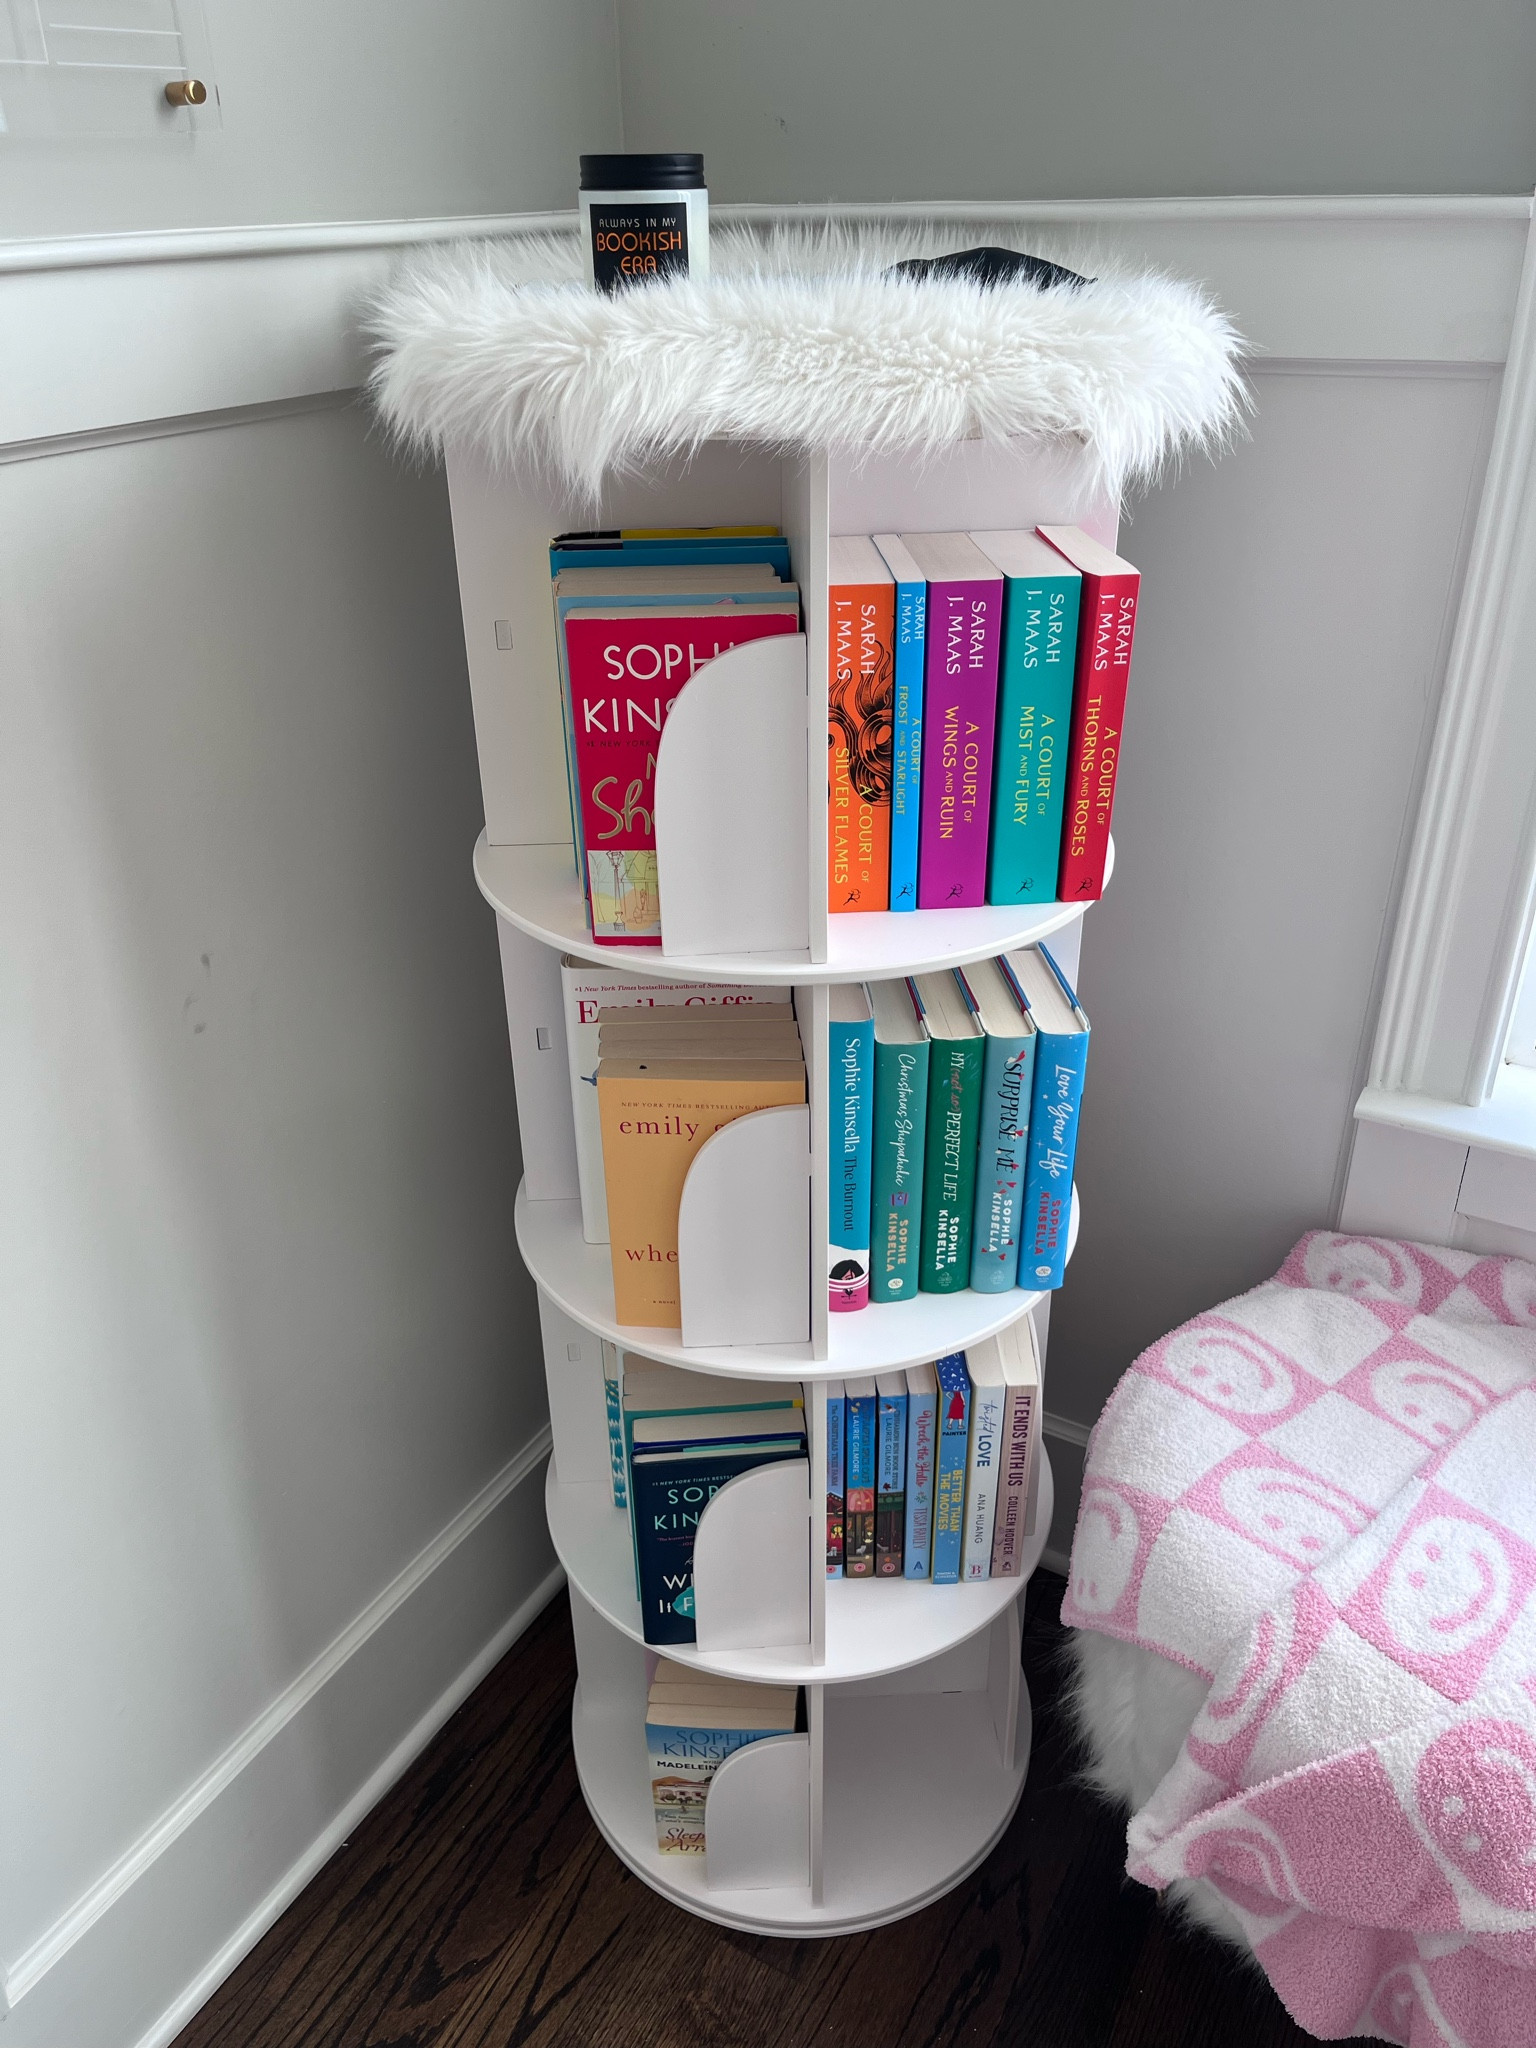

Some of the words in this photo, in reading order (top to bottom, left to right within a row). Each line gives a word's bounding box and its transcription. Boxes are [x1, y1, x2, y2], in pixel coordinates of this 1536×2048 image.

[600, 219, 640, 228] ALWAYS
[646, 218, 657, 227] IN
[662, 218, 677, 226] MY
[596, 231, 682, 252] BOOKISH
[620, 256, 657, 274] ERA
[834, 601, 852, 611] J.
[947, 596, 964, 606] J.
[1026, 590, 1042, 600] J.
[1100, 594, 1115, 604] J.
[901, 606, 912, 644] MAAS
[914, 596, 925, 640] SARAH
[968, 601, 986, 668] SARAH
[1046, 593, 1064, 662] SARAH
[1113, 597, 1134, 665] SARAH
[836, 620, 852, 680] MAAS
[860, 604, 876, 674] SARAH
[946, 616, 963, 674] MAAS
[1024, 610, 1042, 668] MAAS
[1094, 613, 1113, 671] MAAS
[603, 642, 735, 680] SOPH
[898, 686, 909, 724] FROST
[912, 718, 920, 726] A
[1042, 714, 1056, 728] A
[943, 705, 959, 768] WINGS
[966, 721, 980, 735] A
[1018, 706, 1035, 750] MIST
[1080, 695, 1102, 771] THORNS
[1104, 727, 1117, 740] A
[910, 730, 921, 771] COURT
[1019, 755, 1028, 776] AND
[1036, 736, 1054, 800] COURT
[835, 748, 849, 808] SILVER
[860, 784, 872, 796] A
[896, 750, 906, 815] STARLIGHT
[945, 771, 953, 792] AND
[962, 742, 978, 807] COURT
[1080, 776, 1089, 796] AND
[1096, 747, 1115, 810] COURT
[940, 796, 954, 839] RUIN
[964, 810, 972, 823] OF
[1013, 780, 1030, 826] FURY
[1037, 803, 1045, 816] OF
[1097, 813, 1105, 826] OF
[858, 804, 872, 864] COURT
[1071, 800, 1089, 856] ROSES
[834, 815, 848, 884] FLAMES
[861, 870, 869, 882] OF
[638, 984, 674, 992] bestselling
[842, 1038, 861, 1091] Sophie
[951, 1052, 964, 1069] MY
[896, 1053, 916, 1117] Christmas
[1055, 1064, 1077, 1099] Love
[997, 1061, 1022, 1142] SURPRISE
[619, 1115, 700, 1141] emily
[844, 1095, 861, 1152] Kinsella
[944, 1111, 962, 1170] PERFECT
[1048, 1101, 1074, 1145] Your
[844, 1156, 857, 1182] The
[890, 1116, 913, 1187] Shopaholic
[996, 1148, 1015, 1174] ME
[1039, 1148, 1069, 1179] Life
[943, 1173, 958, 1202] LIFE
[844, 1183, 856, 1231] Burnout
[989, 1192, 1002, 1252] KINSELLA
[1001, 1199, 1012, 1244] SOPHIE
[1034, 1192, 1050, 1255] KINSELLA
[1047, 1200, 1061, 1247] SOPHIE
[886, 1213, 898, 1272] KINSELLA
[898, 1219, 909, 1264] SOPHIE
[936, 1210, 949, 1270] KINSELLA
[947, 1216, 960, 1263] SOPHIE
[1016, 1396, 1031, 1406] IT
[916, 1410, 932, 1446] Wreck
[1012, 1410, 1029, 1438] ENDS
[917, 1446, 929, 1460] the
[977, 1435, 992, 1467] LOVE
[1010, 1442, 1026, 1469] WITH
[915, 1462, 930, 1488] Halls
[940, 1472, 951, 1489] THE
[951, 1469, 963, 1503] BETTER
[1008, 1472, 1023, 1486] US
[914, 1508, 928, 1527] TESSA
[938, 1493, 950, 1530] MOVIES
[950, 1506, 961, 1532] THAN
[977, 1493, 986, 1511] ANA
[1006, 1496, 1018, 1526] COLLEEN
[913, 1528, 926, 1549] BAILEY
[975, 1514, 984, 1544] HUANG
[1003, 1528, 1015, 1555] HOOVER
